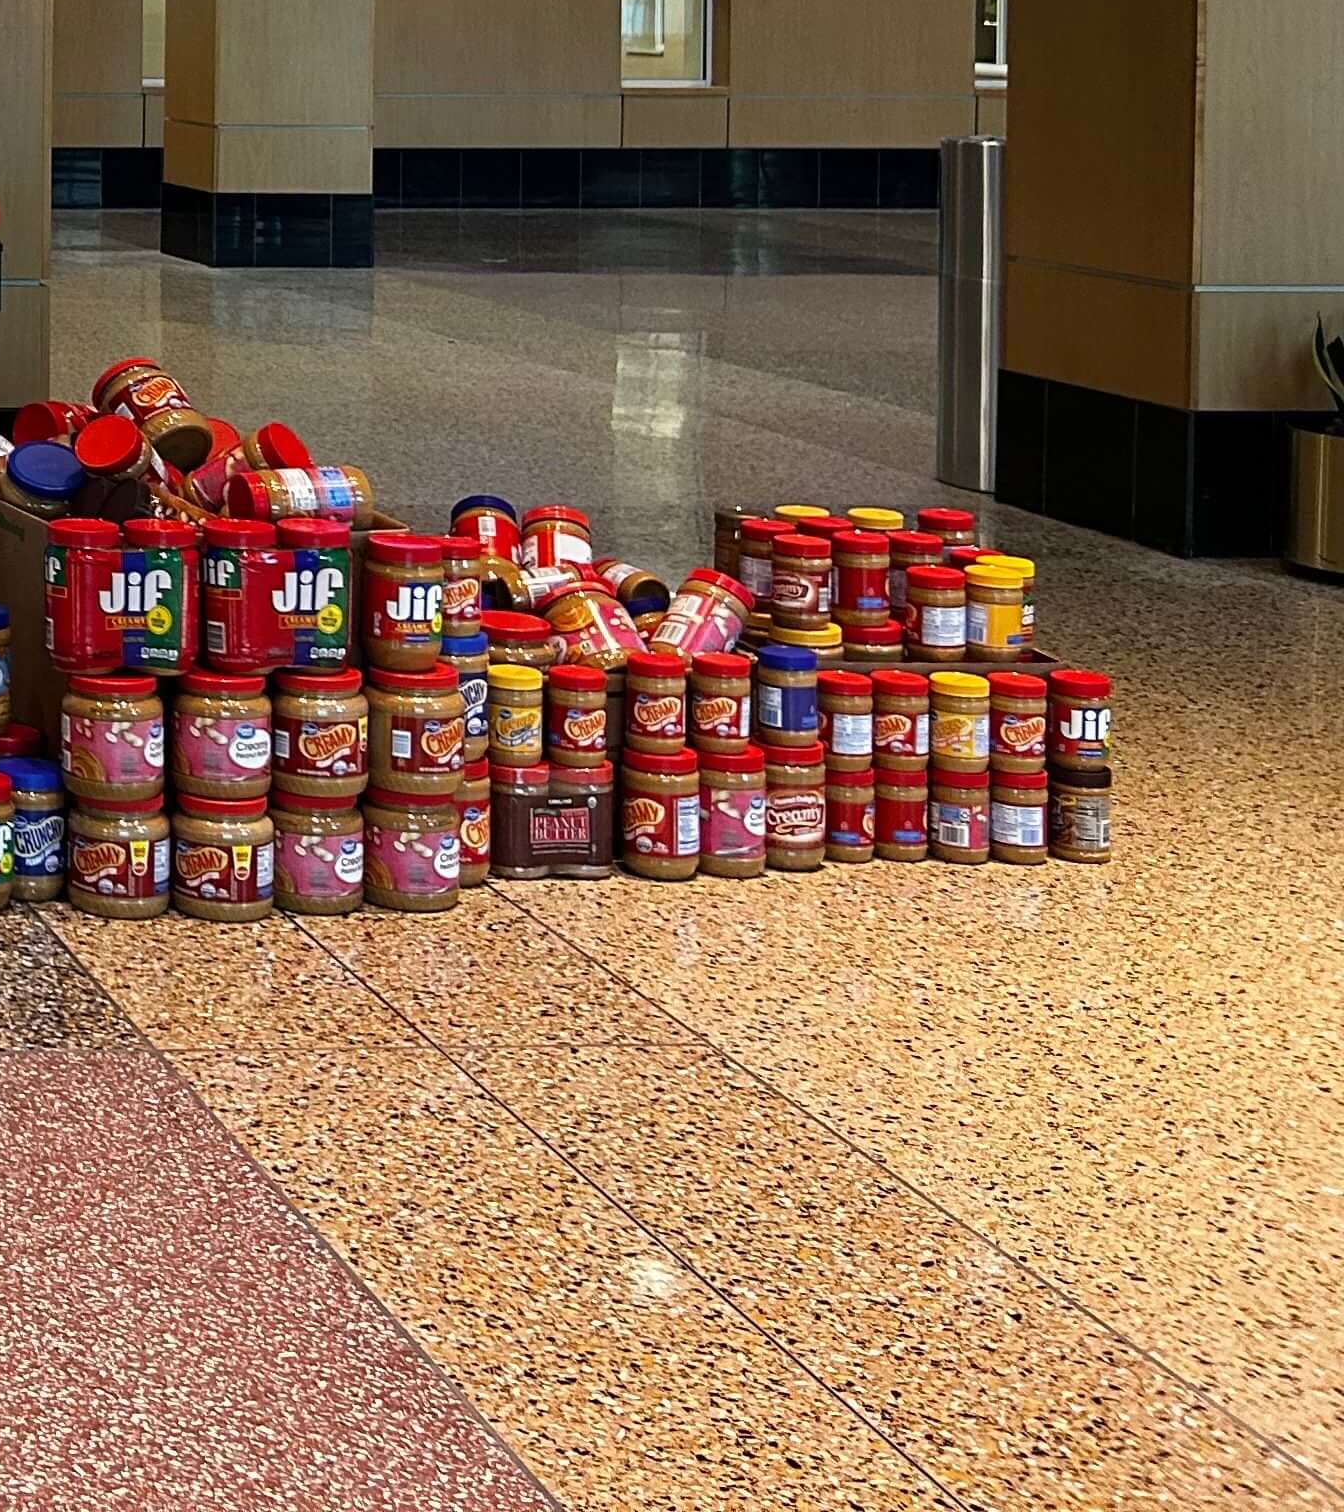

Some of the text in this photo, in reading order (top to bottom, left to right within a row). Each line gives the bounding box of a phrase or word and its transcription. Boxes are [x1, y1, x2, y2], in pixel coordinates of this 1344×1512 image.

[99, 569, 172, 613] Jif
[271, 568, 345, 612] Jif
[386, 585, 441, 621] Jif
[634, 699, 680, 726] CREAMY
[1060, 708, 1111, 739] Jif
[302, 727, 355, 759] CREAMY
[535, 817, 585, 828] PEANUT
[765, 806, 822, 826] Creamy
[535, 829, 586, 840] BUTTER
